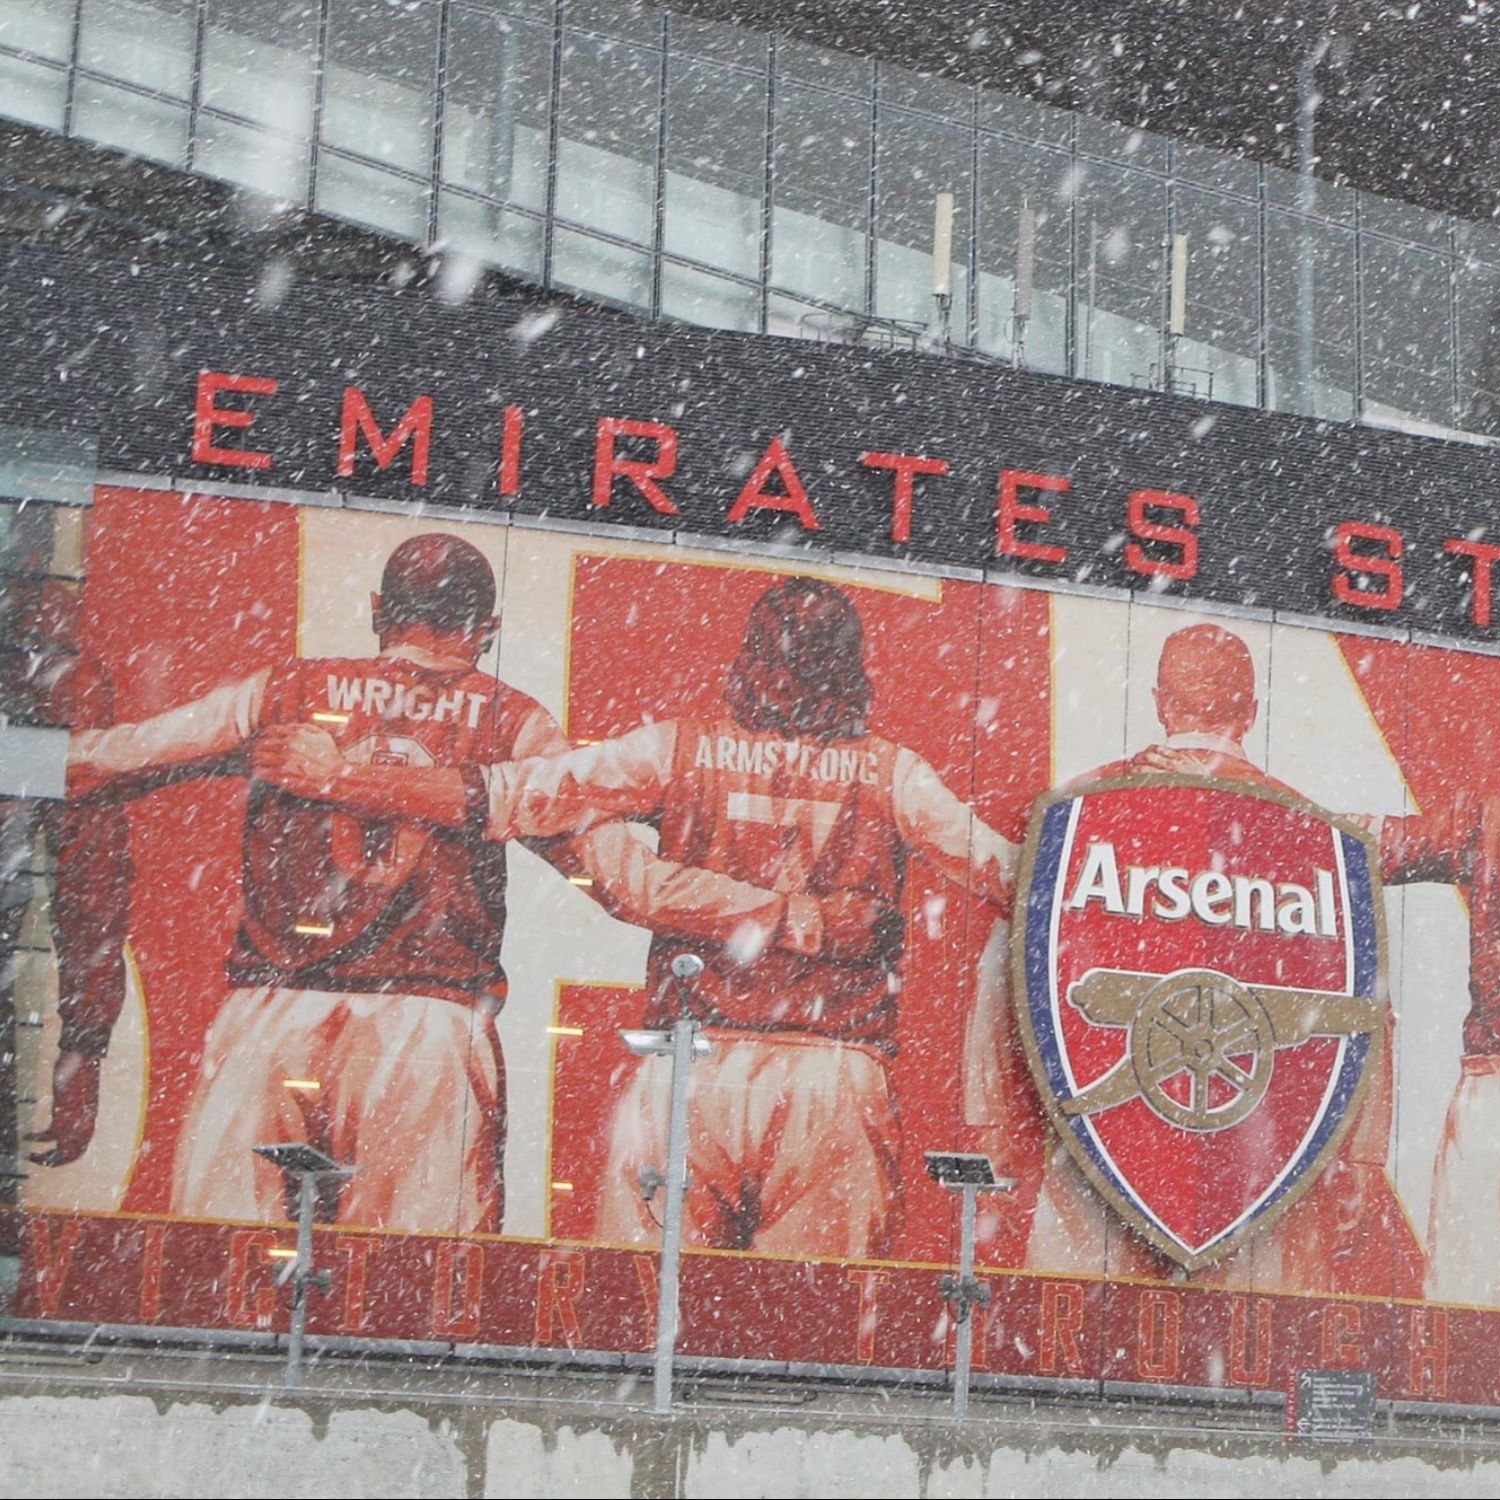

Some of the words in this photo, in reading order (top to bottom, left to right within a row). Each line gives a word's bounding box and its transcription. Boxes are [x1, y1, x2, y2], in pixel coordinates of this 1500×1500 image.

[190, 370, 1199, 581] EMIRATES
[327, 674, 487, 729] WRIGHT
[694, 735, 879, 785] ARMSTRONG
[1067, 842, 1338, 937] Arsenal
